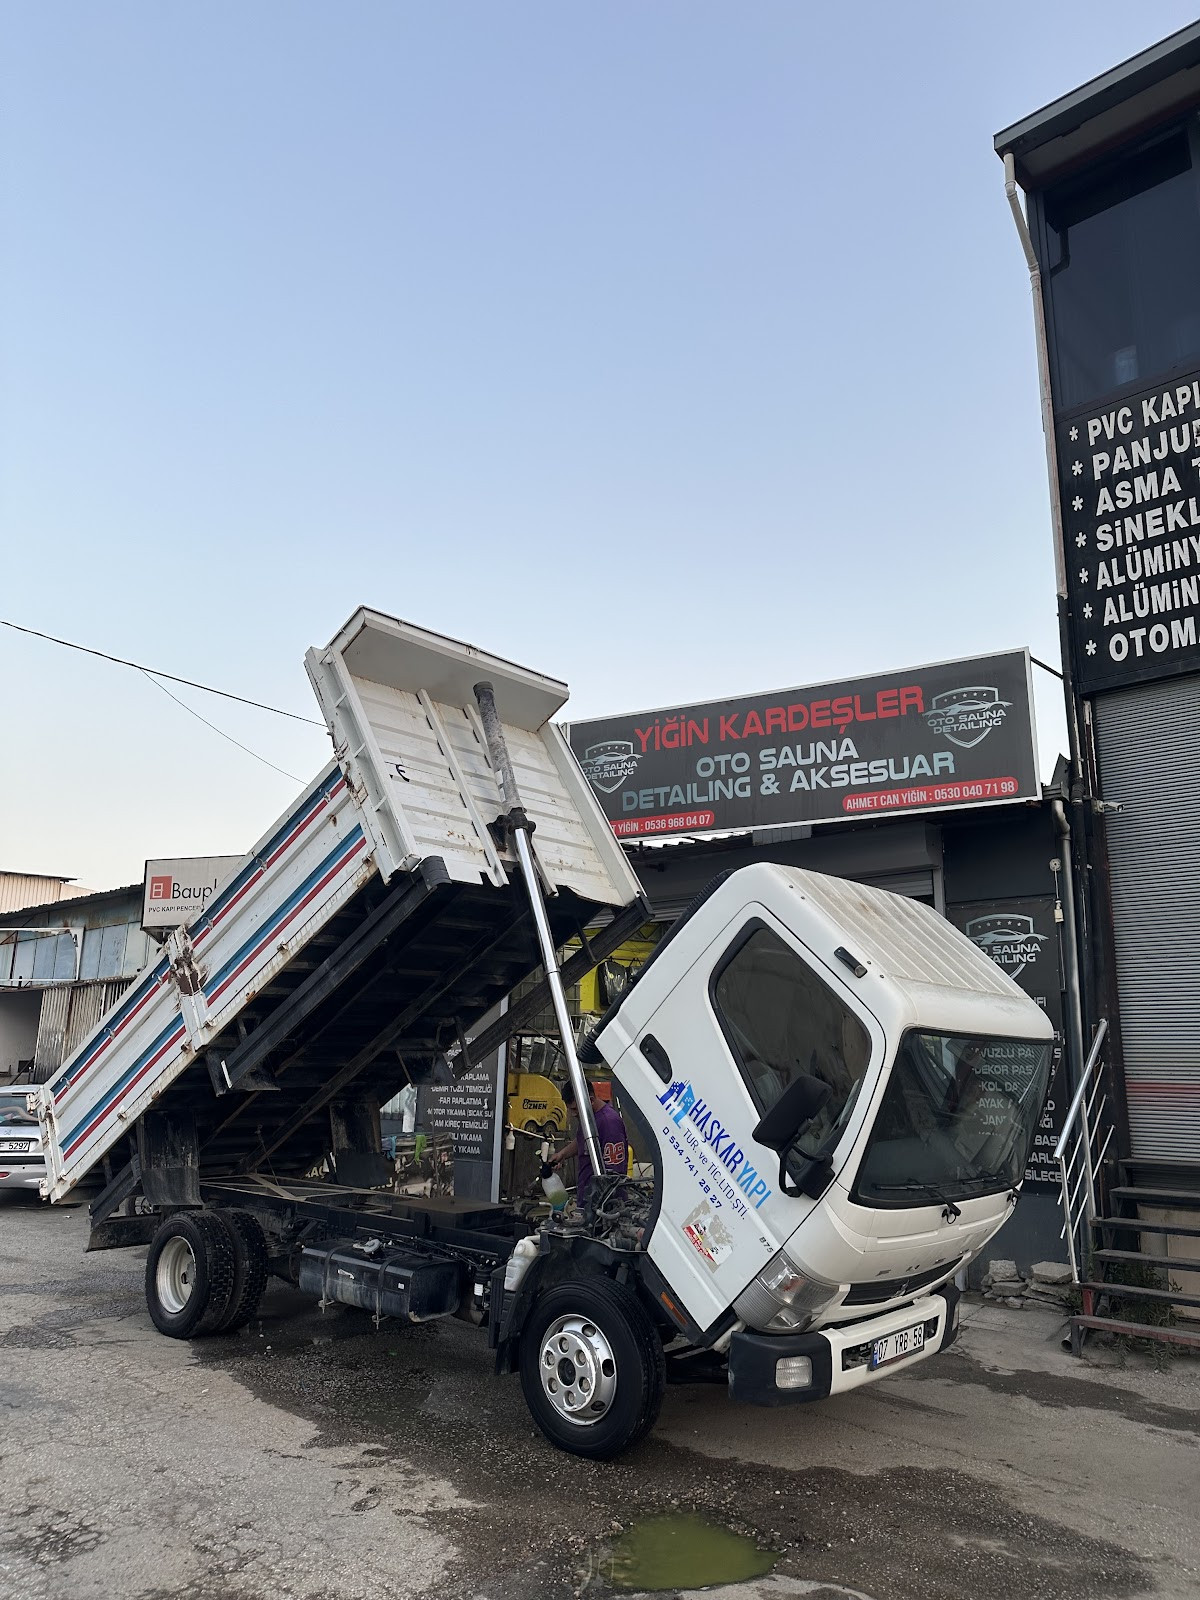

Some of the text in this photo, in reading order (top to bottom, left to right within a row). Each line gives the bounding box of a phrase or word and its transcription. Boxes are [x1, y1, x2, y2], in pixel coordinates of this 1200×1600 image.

[1087, 406, 1134, 447] PVC
[1095, 466, 1182, 517] ASMA
[1108, 616, 1200, 662] OTOM
[634, 685, 925, 753] YİĞİN KARDEŞLER
[927, 708, 1007, 727] OTO SAUNA
[933, 717, 1002, 735] DETAILING
[603, 760, 638, 772] SAUNA
[696, 737, 860, 779] OTO SAUNA
[622, 750, 956, 812] DETAILING & AKSESUAR
[846, 795, 878, 810] AHMET
[880, 793, 900, 807] CAN
[901, 789, 927, 804] YİĞİN
[934, 786, 961, 801] 0530
[962, 784, 983, 798] 040
[985, 782, 998, 795] 71
[1001, 780, 1015, 793] 98
[618, 820, 639, 833] YİĞİN
[645, 818, 667, 831] 0536
[668, 817, 685, 829] 968
[686, 815, 698, 826] 04
[699, 814, 711, 825] 07
[993, 943, 1041, 954] SAUNA
[451, 1097, 483, 1105] PARLATMA
[446, 1108, 467, 1116] YIKAMA
[444, 1118, 461, 1130] KİREÇ
[461, 1119, 489, 1130] TEMİZLİĞİ
[8, 1142, 29, 1150] 5297
[460, 1133, 482, 1142] YIKAMA
[683, 1127, 700, 1155] TUR.
[699, 1152, 708, 1165] ve
[458, 1145, 481, 1154] YIKAMA
[669, 1135, 684, 1157] 534
[684, 1156, 699, 1177] 741
[698, 1178, 711, 1194] 28
[709, 1193, 723, 1210] 27
[878, 1338, 889, 1361] 07
[894, 1332, 909, 1355] YRB
[913, 1326, 923, 1348] 58
